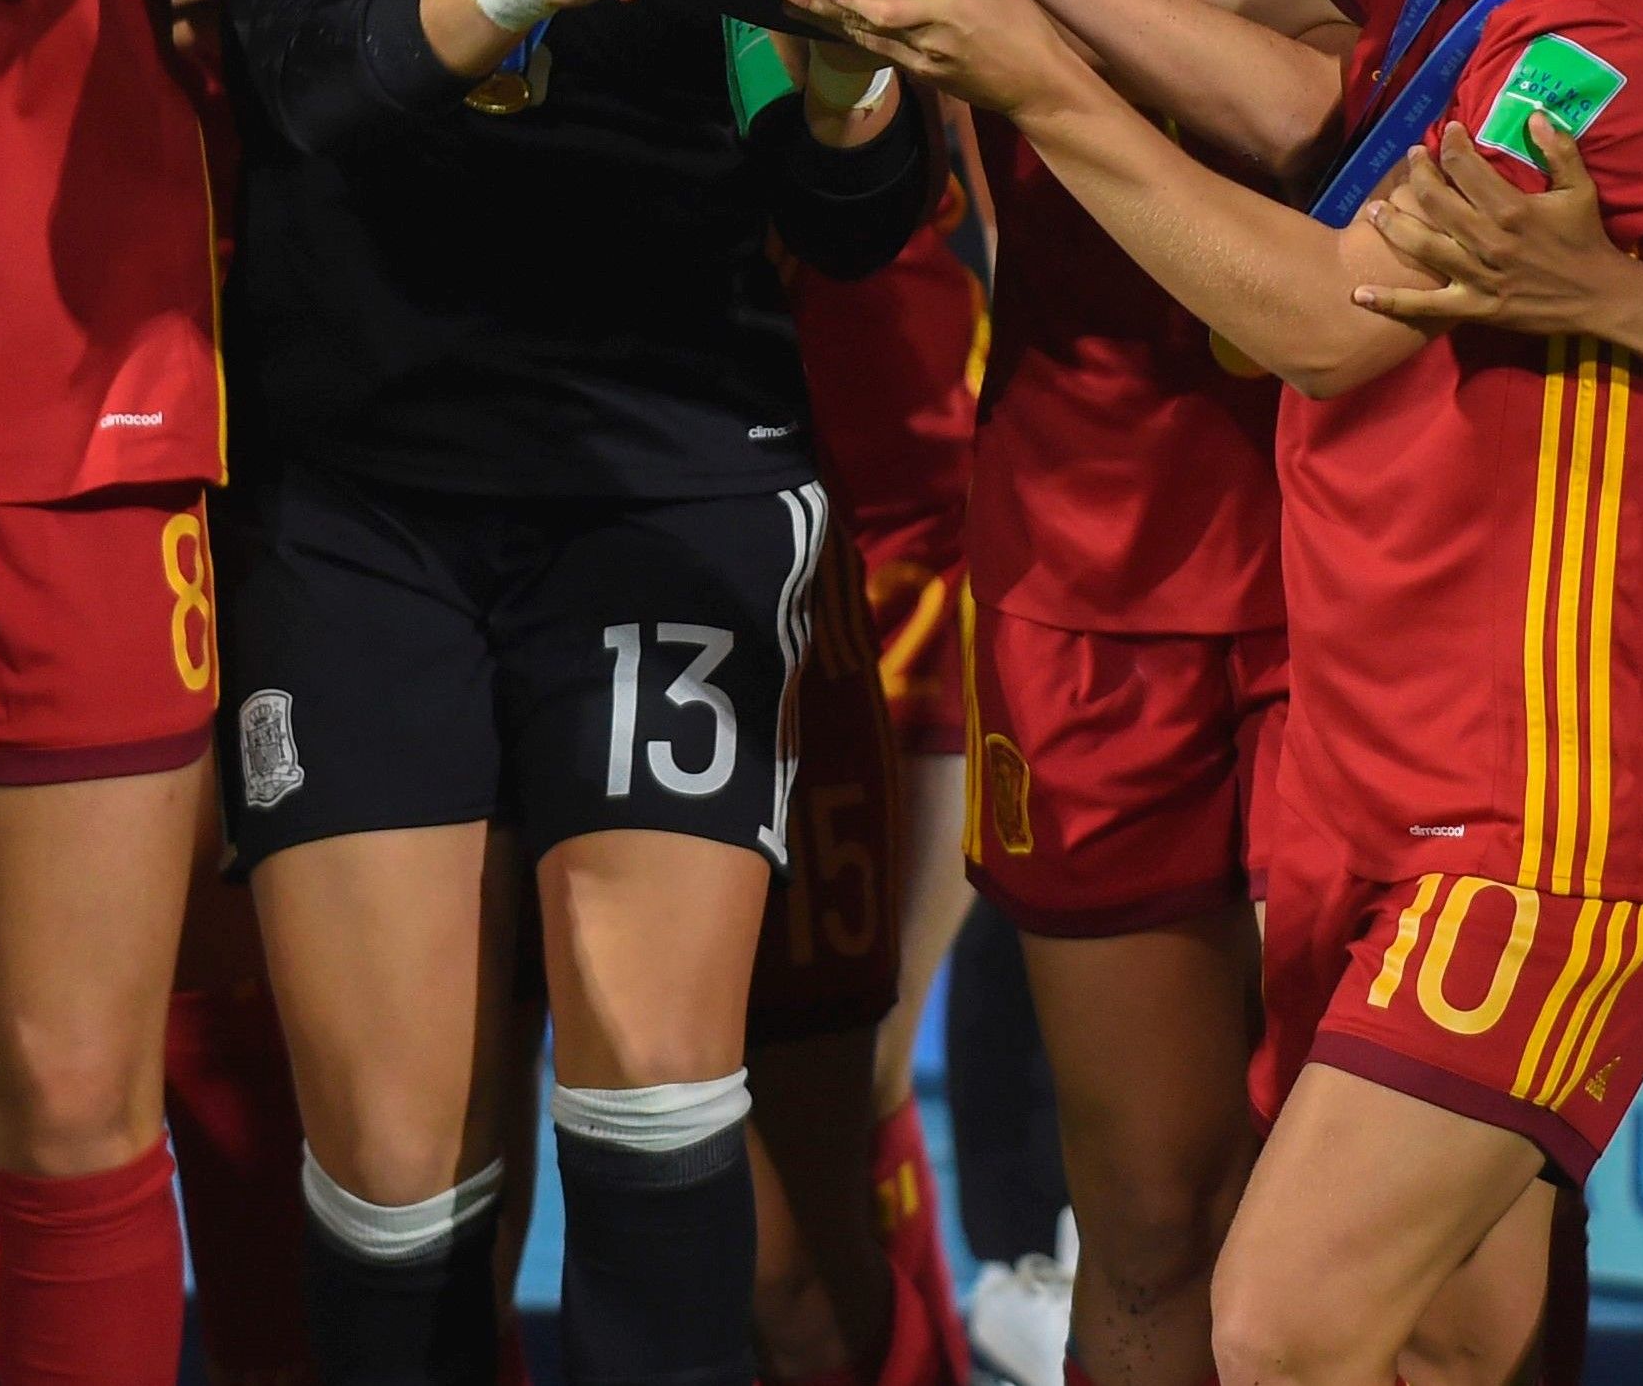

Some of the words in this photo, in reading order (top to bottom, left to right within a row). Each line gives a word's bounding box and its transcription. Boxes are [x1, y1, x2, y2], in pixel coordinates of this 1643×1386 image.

[160, 511, 212, 691] 8
[602, 620, 739, 800] 13
[1366, 872, 1541, 1035] 10
